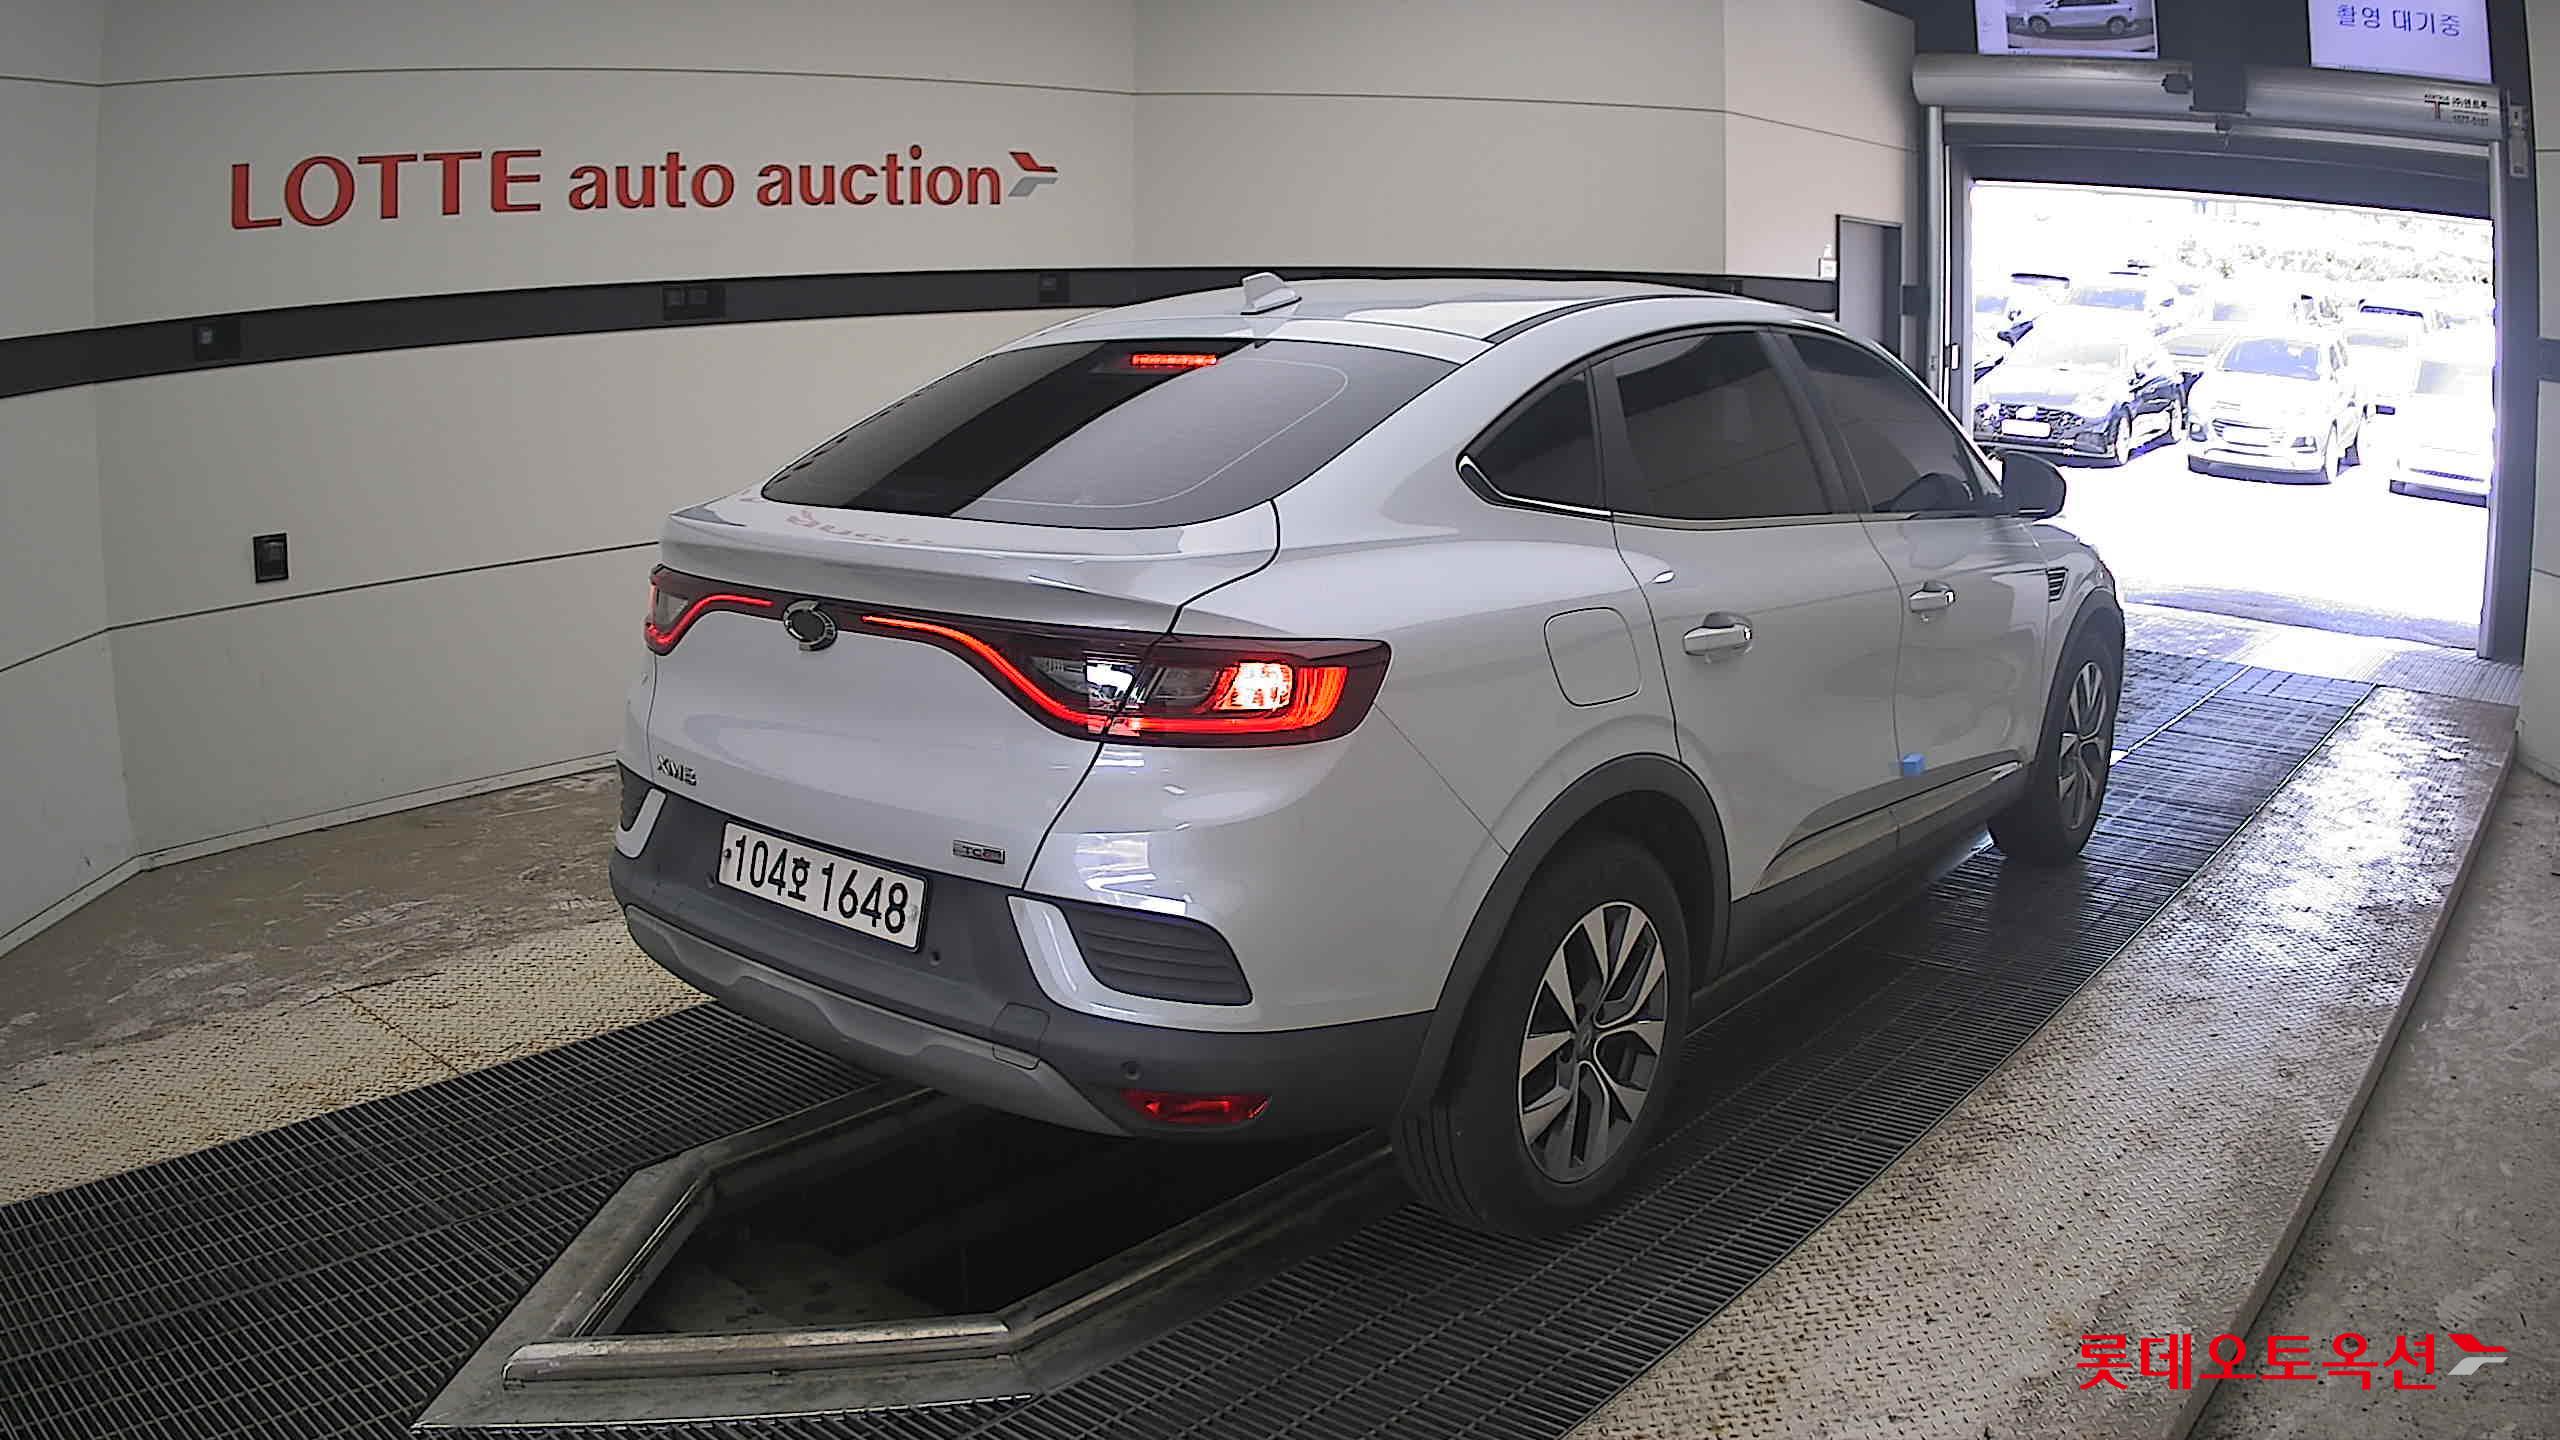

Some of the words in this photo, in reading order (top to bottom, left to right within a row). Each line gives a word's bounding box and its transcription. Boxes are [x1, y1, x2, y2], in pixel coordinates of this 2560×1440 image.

[2337, 3, 2381, 30] 촬영
[2392, 9, 2461, 37] 대기중
[231, 149, 543, 230] LOTTE
[568, 152, 736, 209] auto
[756, 145, 1002, 206] auction
[736, 835, 811, 902] 104호
[822, 862, 909, 934] 1648
